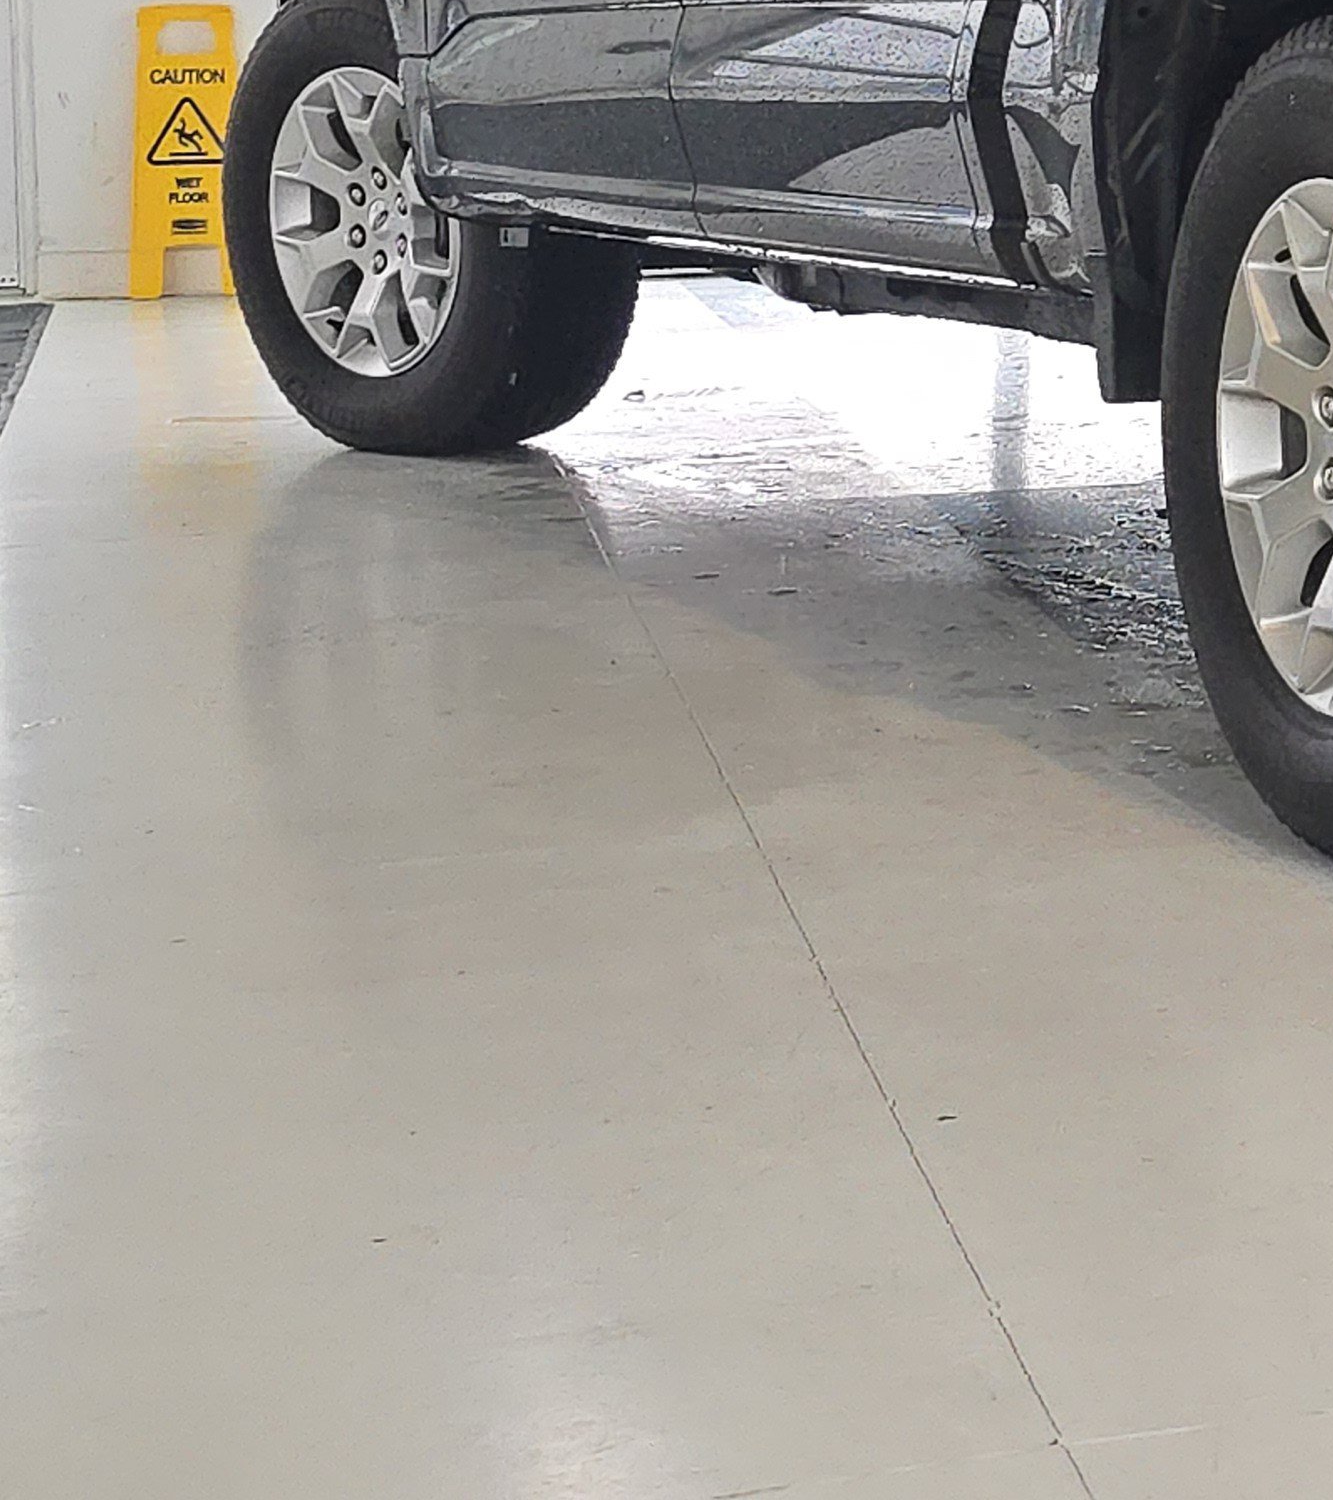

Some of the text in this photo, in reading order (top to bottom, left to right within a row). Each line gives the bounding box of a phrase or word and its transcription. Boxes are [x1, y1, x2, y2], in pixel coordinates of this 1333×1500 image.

[149, 67, 226, 85] CAUTION
[174, 176, 204, 190] WET
[168, 191, 210, 205] FLOOR
